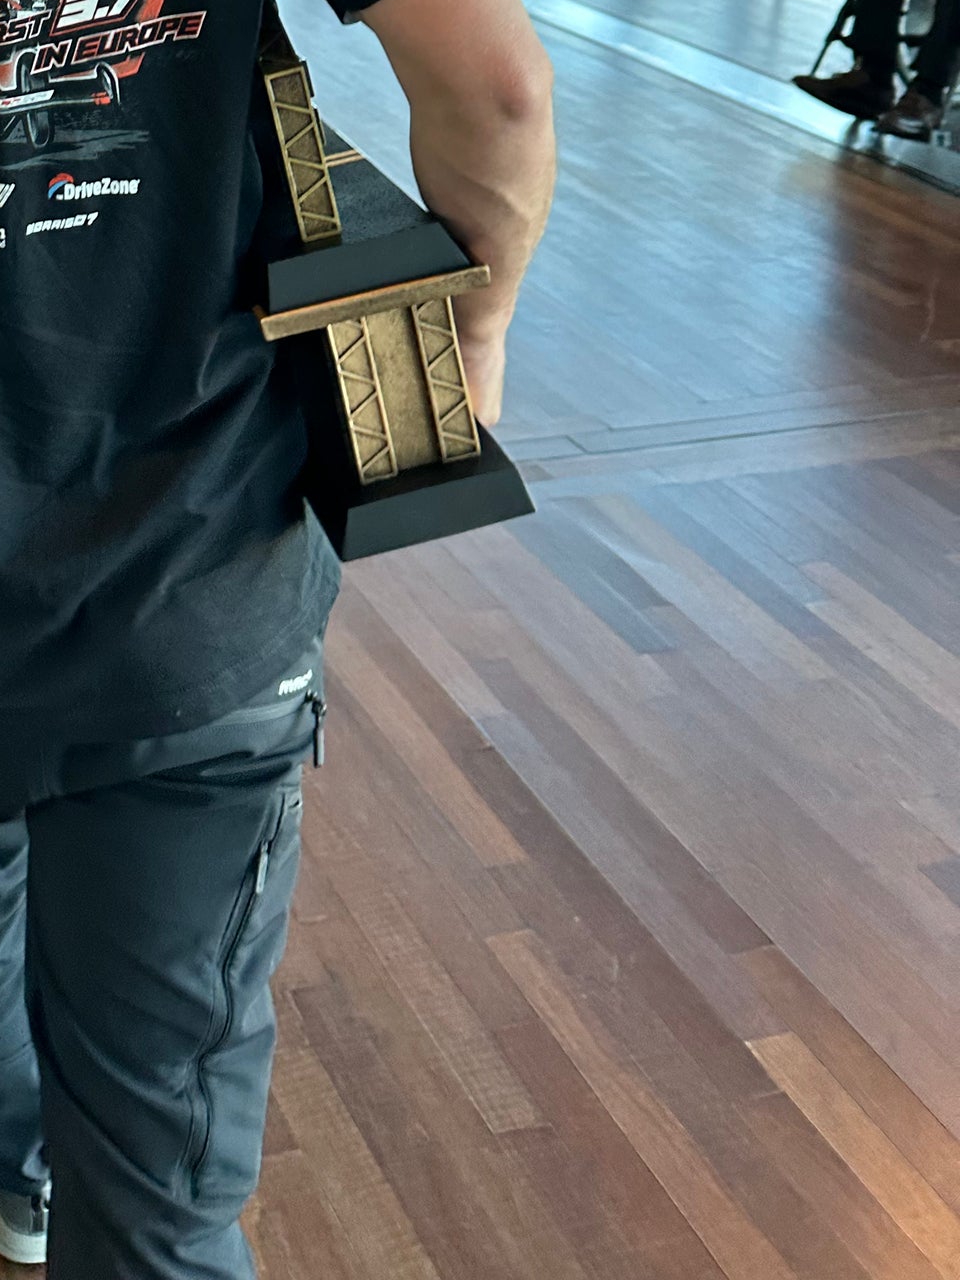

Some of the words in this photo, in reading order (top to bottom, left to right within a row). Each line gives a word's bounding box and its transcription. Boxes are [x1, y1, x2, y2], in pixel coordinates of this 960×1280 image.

[30, 39, 73, 74] IN
[71, 11, 207, 64] EUROPE
[62, 176, 141, 201] DriveZone
